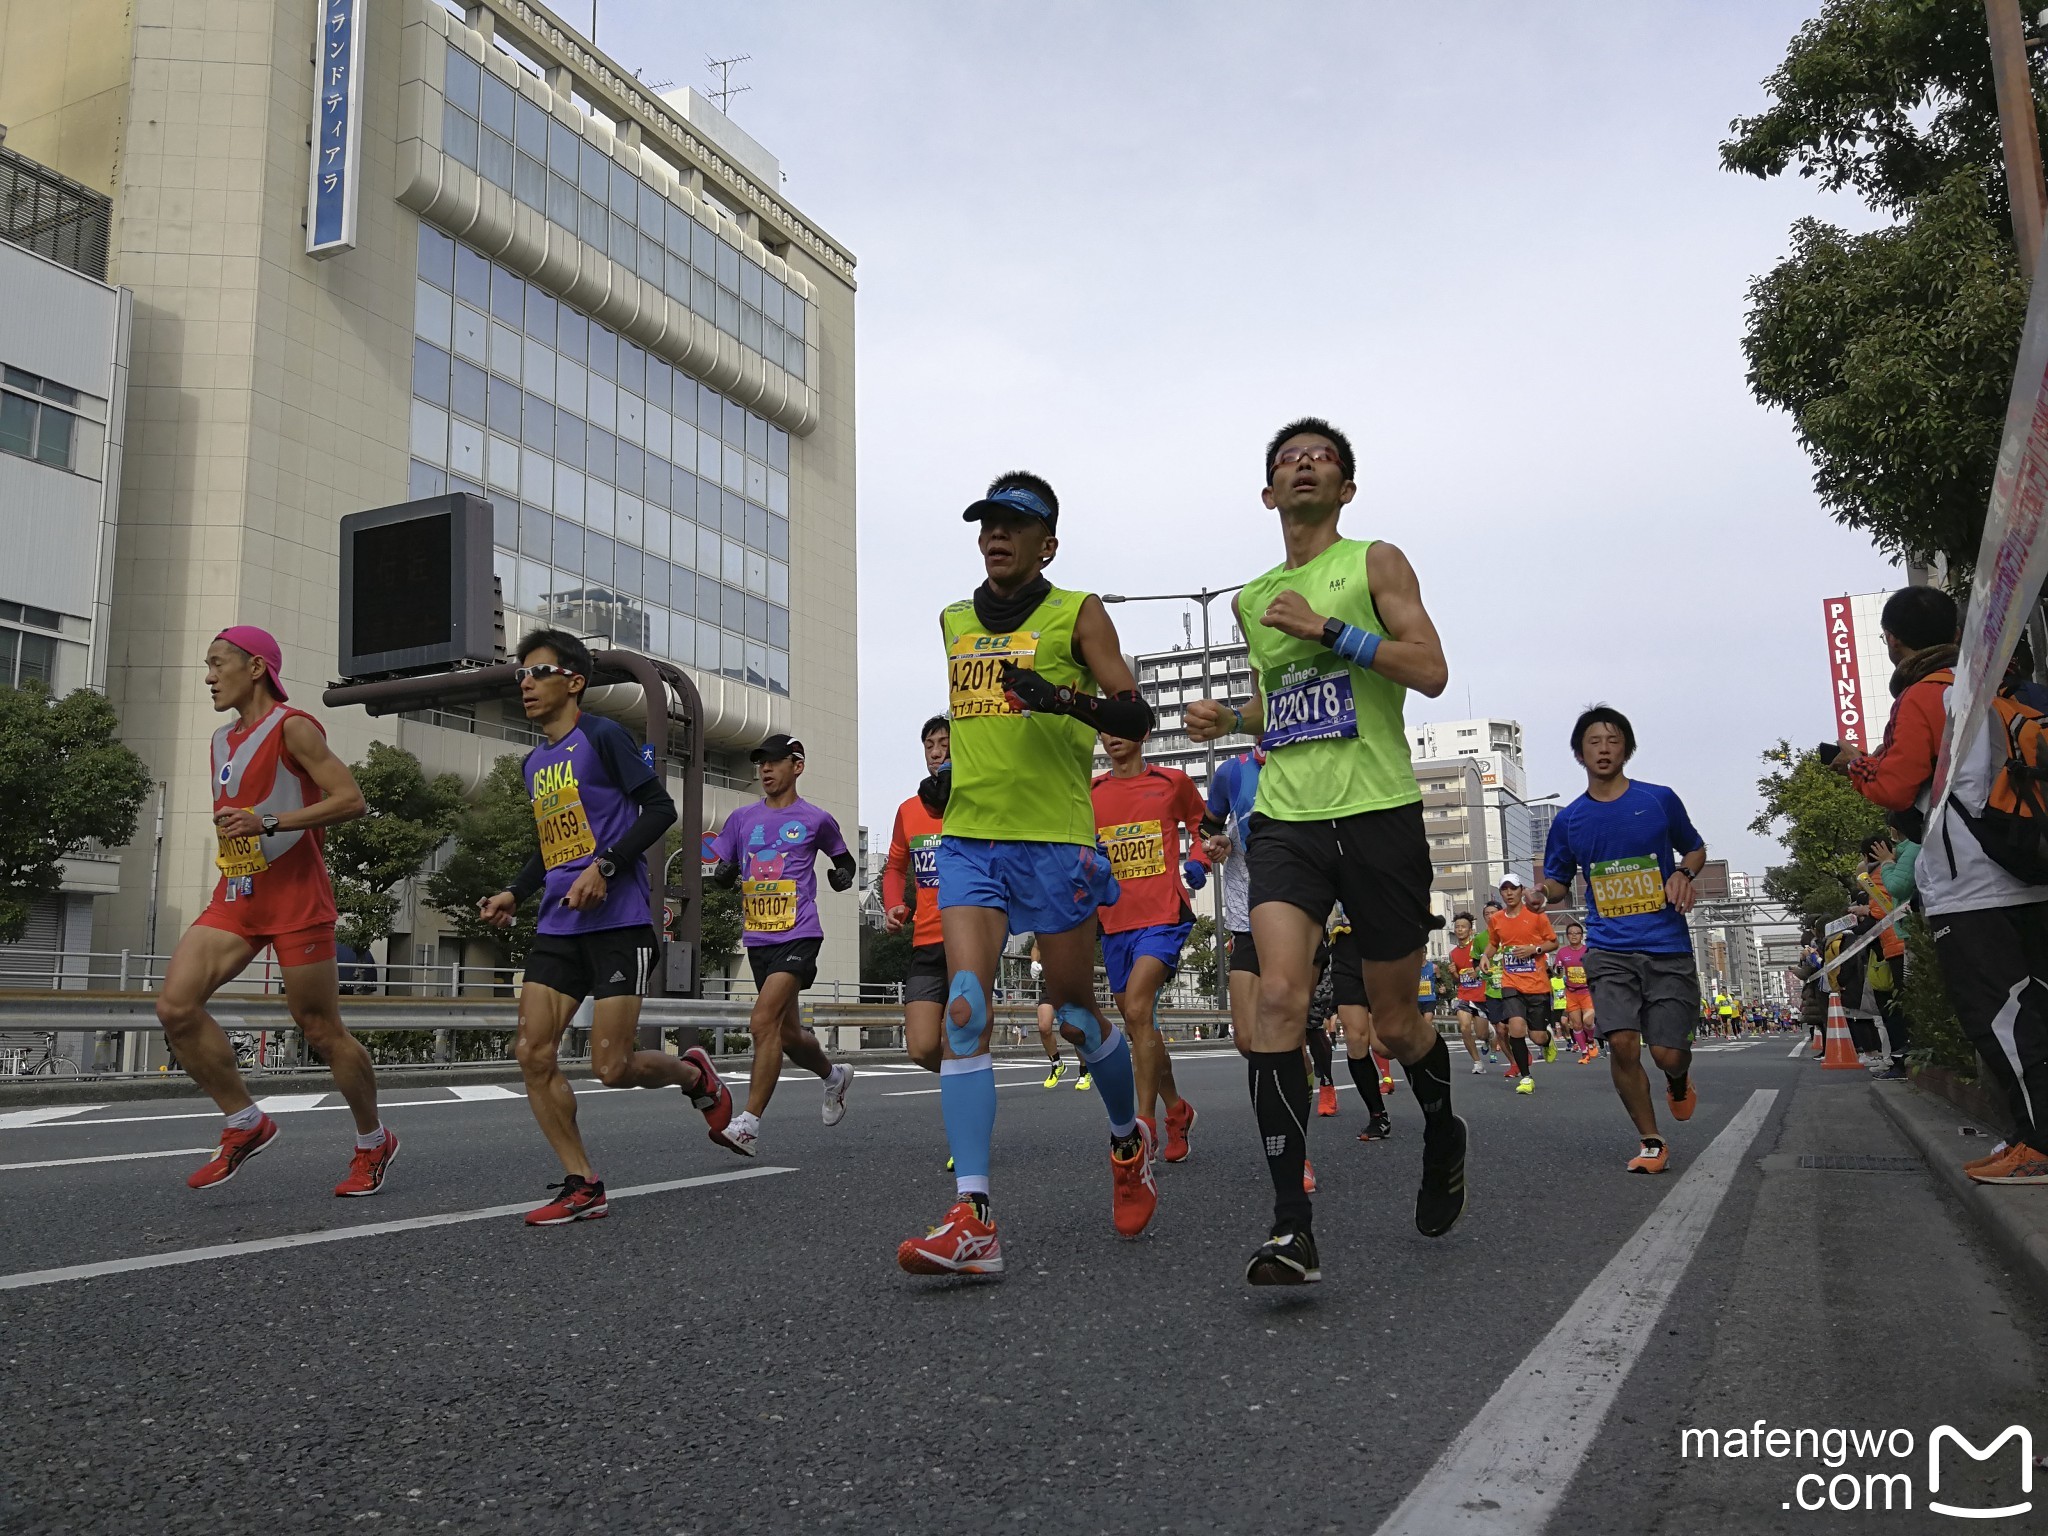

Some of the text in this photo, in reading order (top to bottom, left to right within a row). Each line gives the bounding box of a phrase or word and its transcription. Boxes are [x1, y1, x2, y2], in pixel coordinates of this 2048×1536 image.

[324, 0, 346, 193] ランドティアラ
[974, 636, 1011, 649] eo
[951, 658, 1018, 693] A2014
[1281, 664, 1318, 686] mineo
[1830, 603, 1859, 726] PACHINKO
[1267, 682, 1340, 732] A22078
[542, 794, 559, 811] eo
[1116, 825, 1141, 836] eo
[914, 851, 937, 873] A22
[1605, 861, 1640, 875] mineo
[755, 882, 779, 892] eo
[1594, 873, 1654, 901] B52319
[744, 896, 789, 917] A10107
